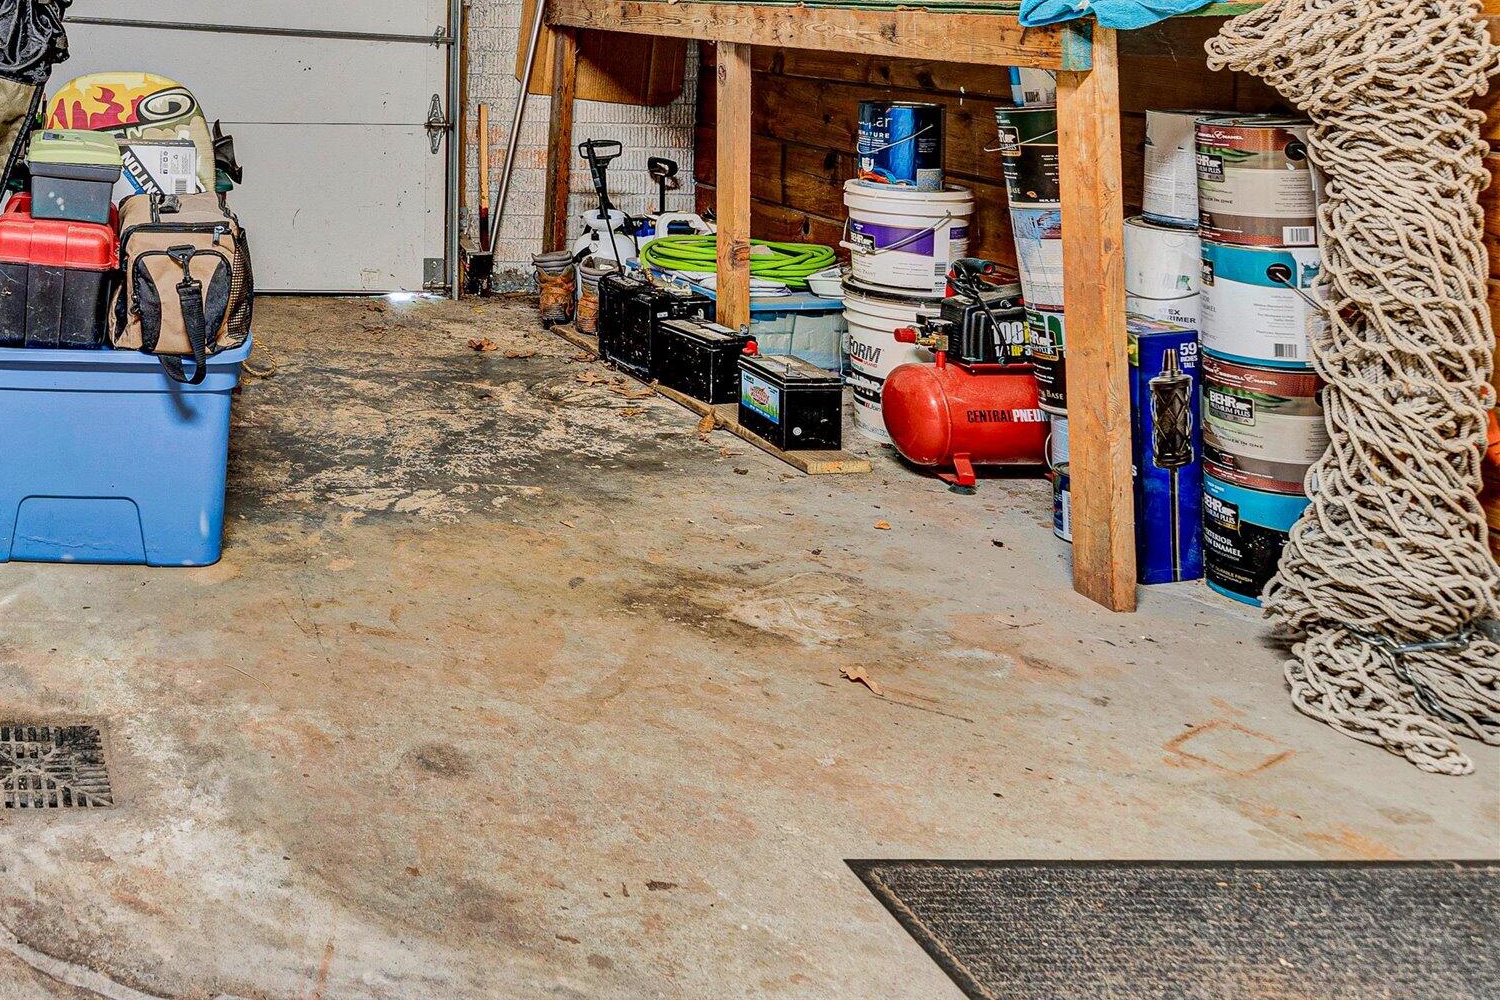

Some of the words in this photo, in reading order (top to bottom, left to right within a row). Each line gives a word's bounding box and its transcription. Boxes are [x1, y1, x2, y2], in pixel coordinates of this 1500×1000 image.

[1169, 315, 1196, 324] RIMER
[1180, 342, 1197, 356] 59
[1209, 391, 1236, 408] BEHR
